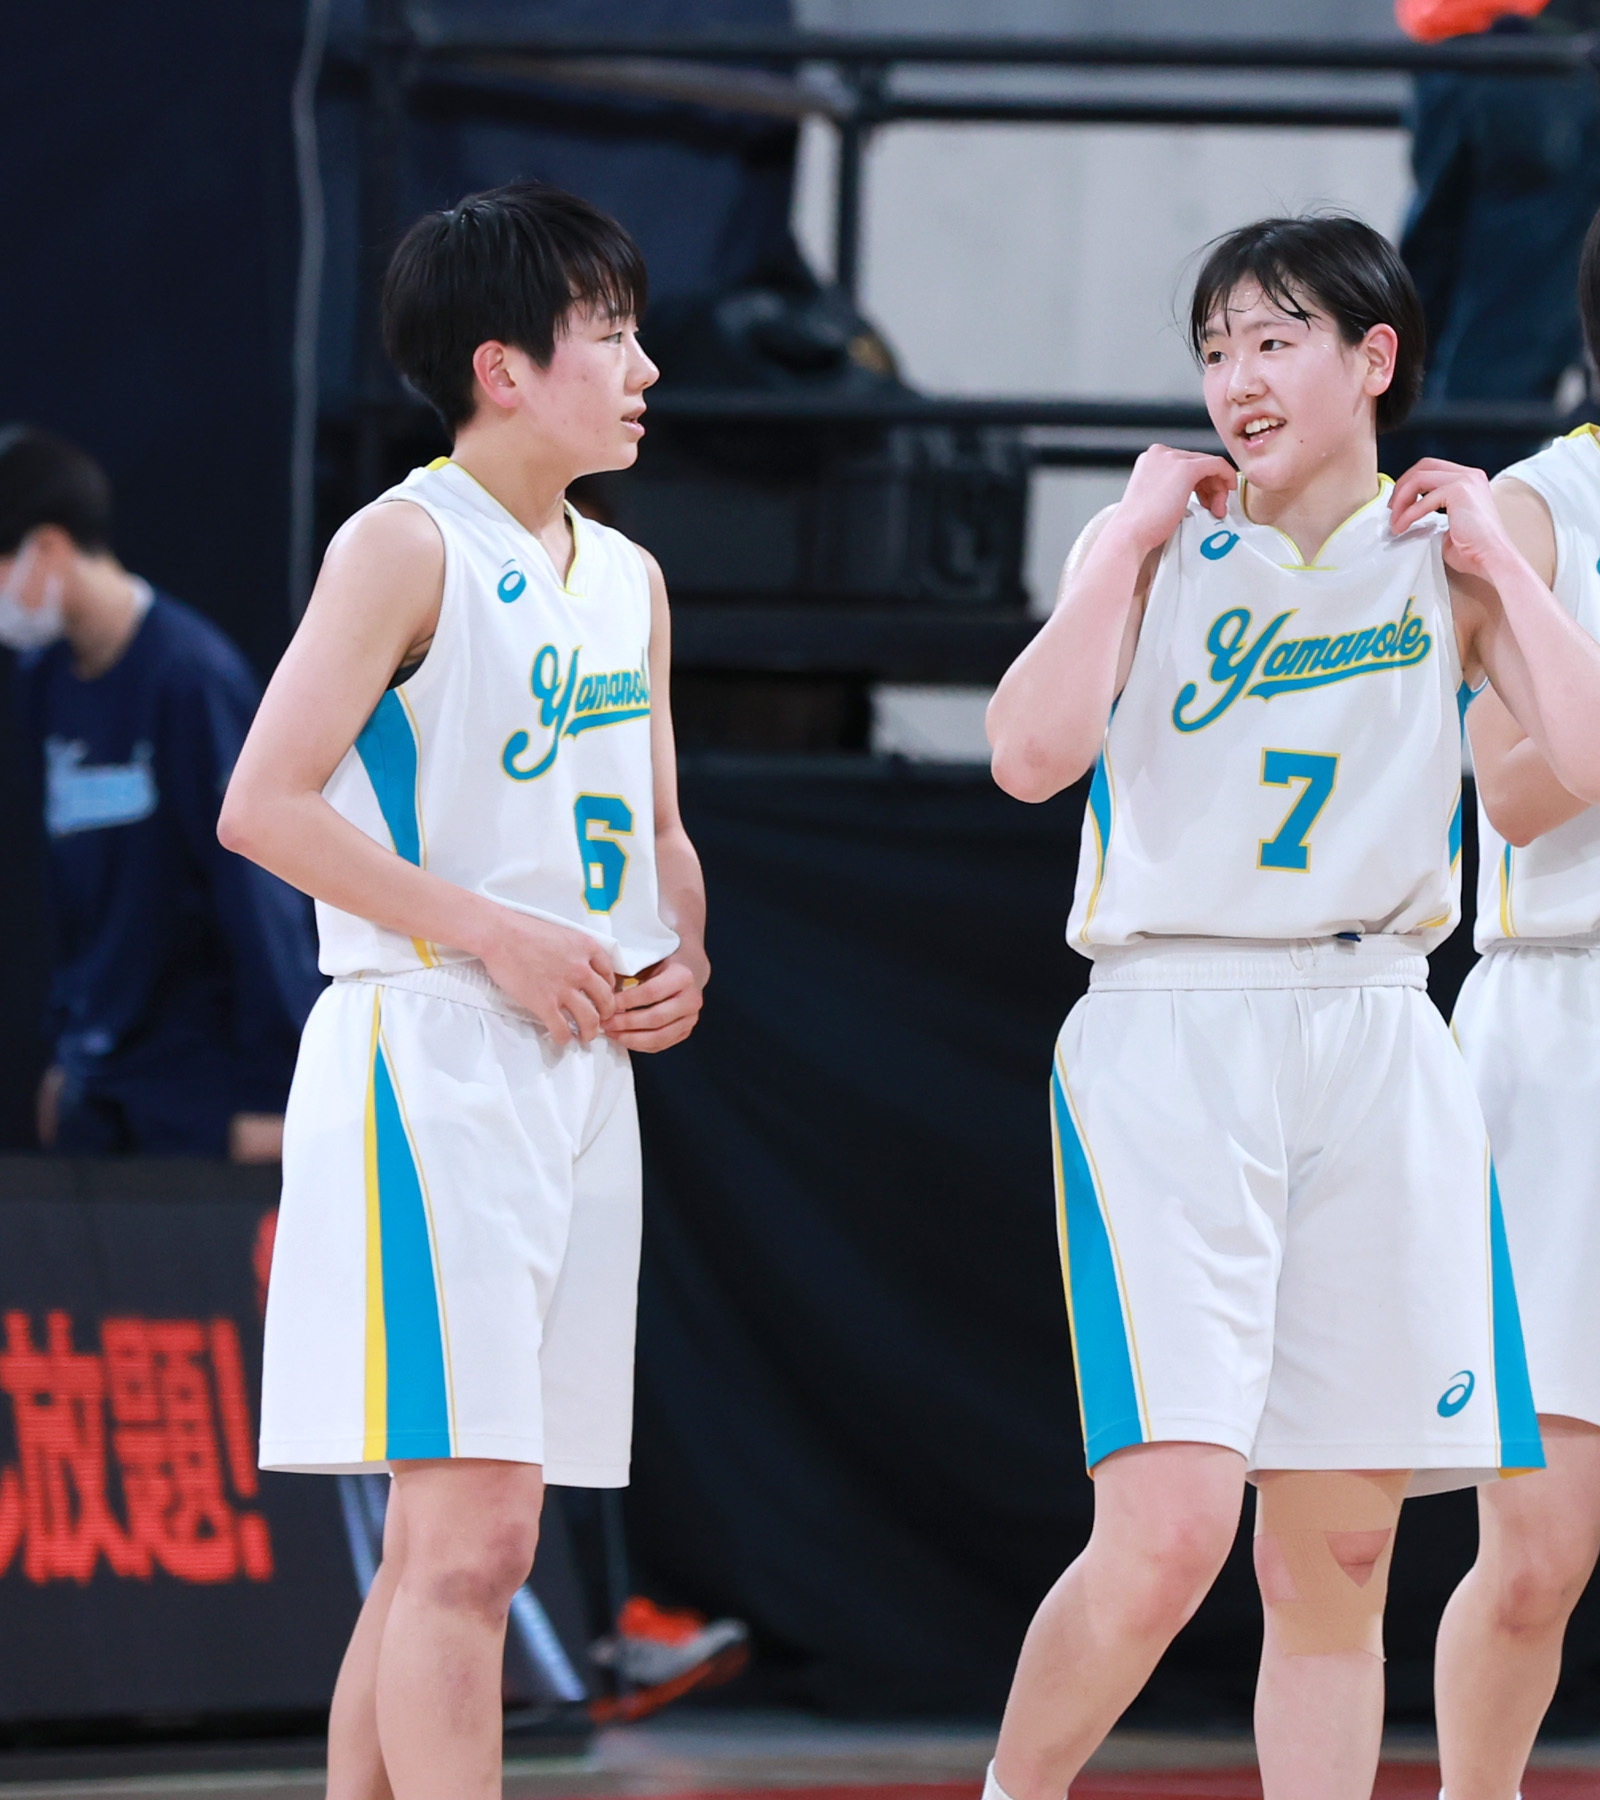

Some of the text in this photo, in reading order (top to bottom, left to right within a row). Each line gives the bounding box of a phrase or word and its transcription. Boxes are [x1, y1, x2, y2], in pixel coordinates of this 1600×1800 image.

[499, 642, 651, 784] Yamanot
[1170, 595, 1434, 735] Yamanote
[572, 791, 635, 916] 6
[1256, 746, 1342, 874] 7
[0, 1307, 276, 1586] 放題!
